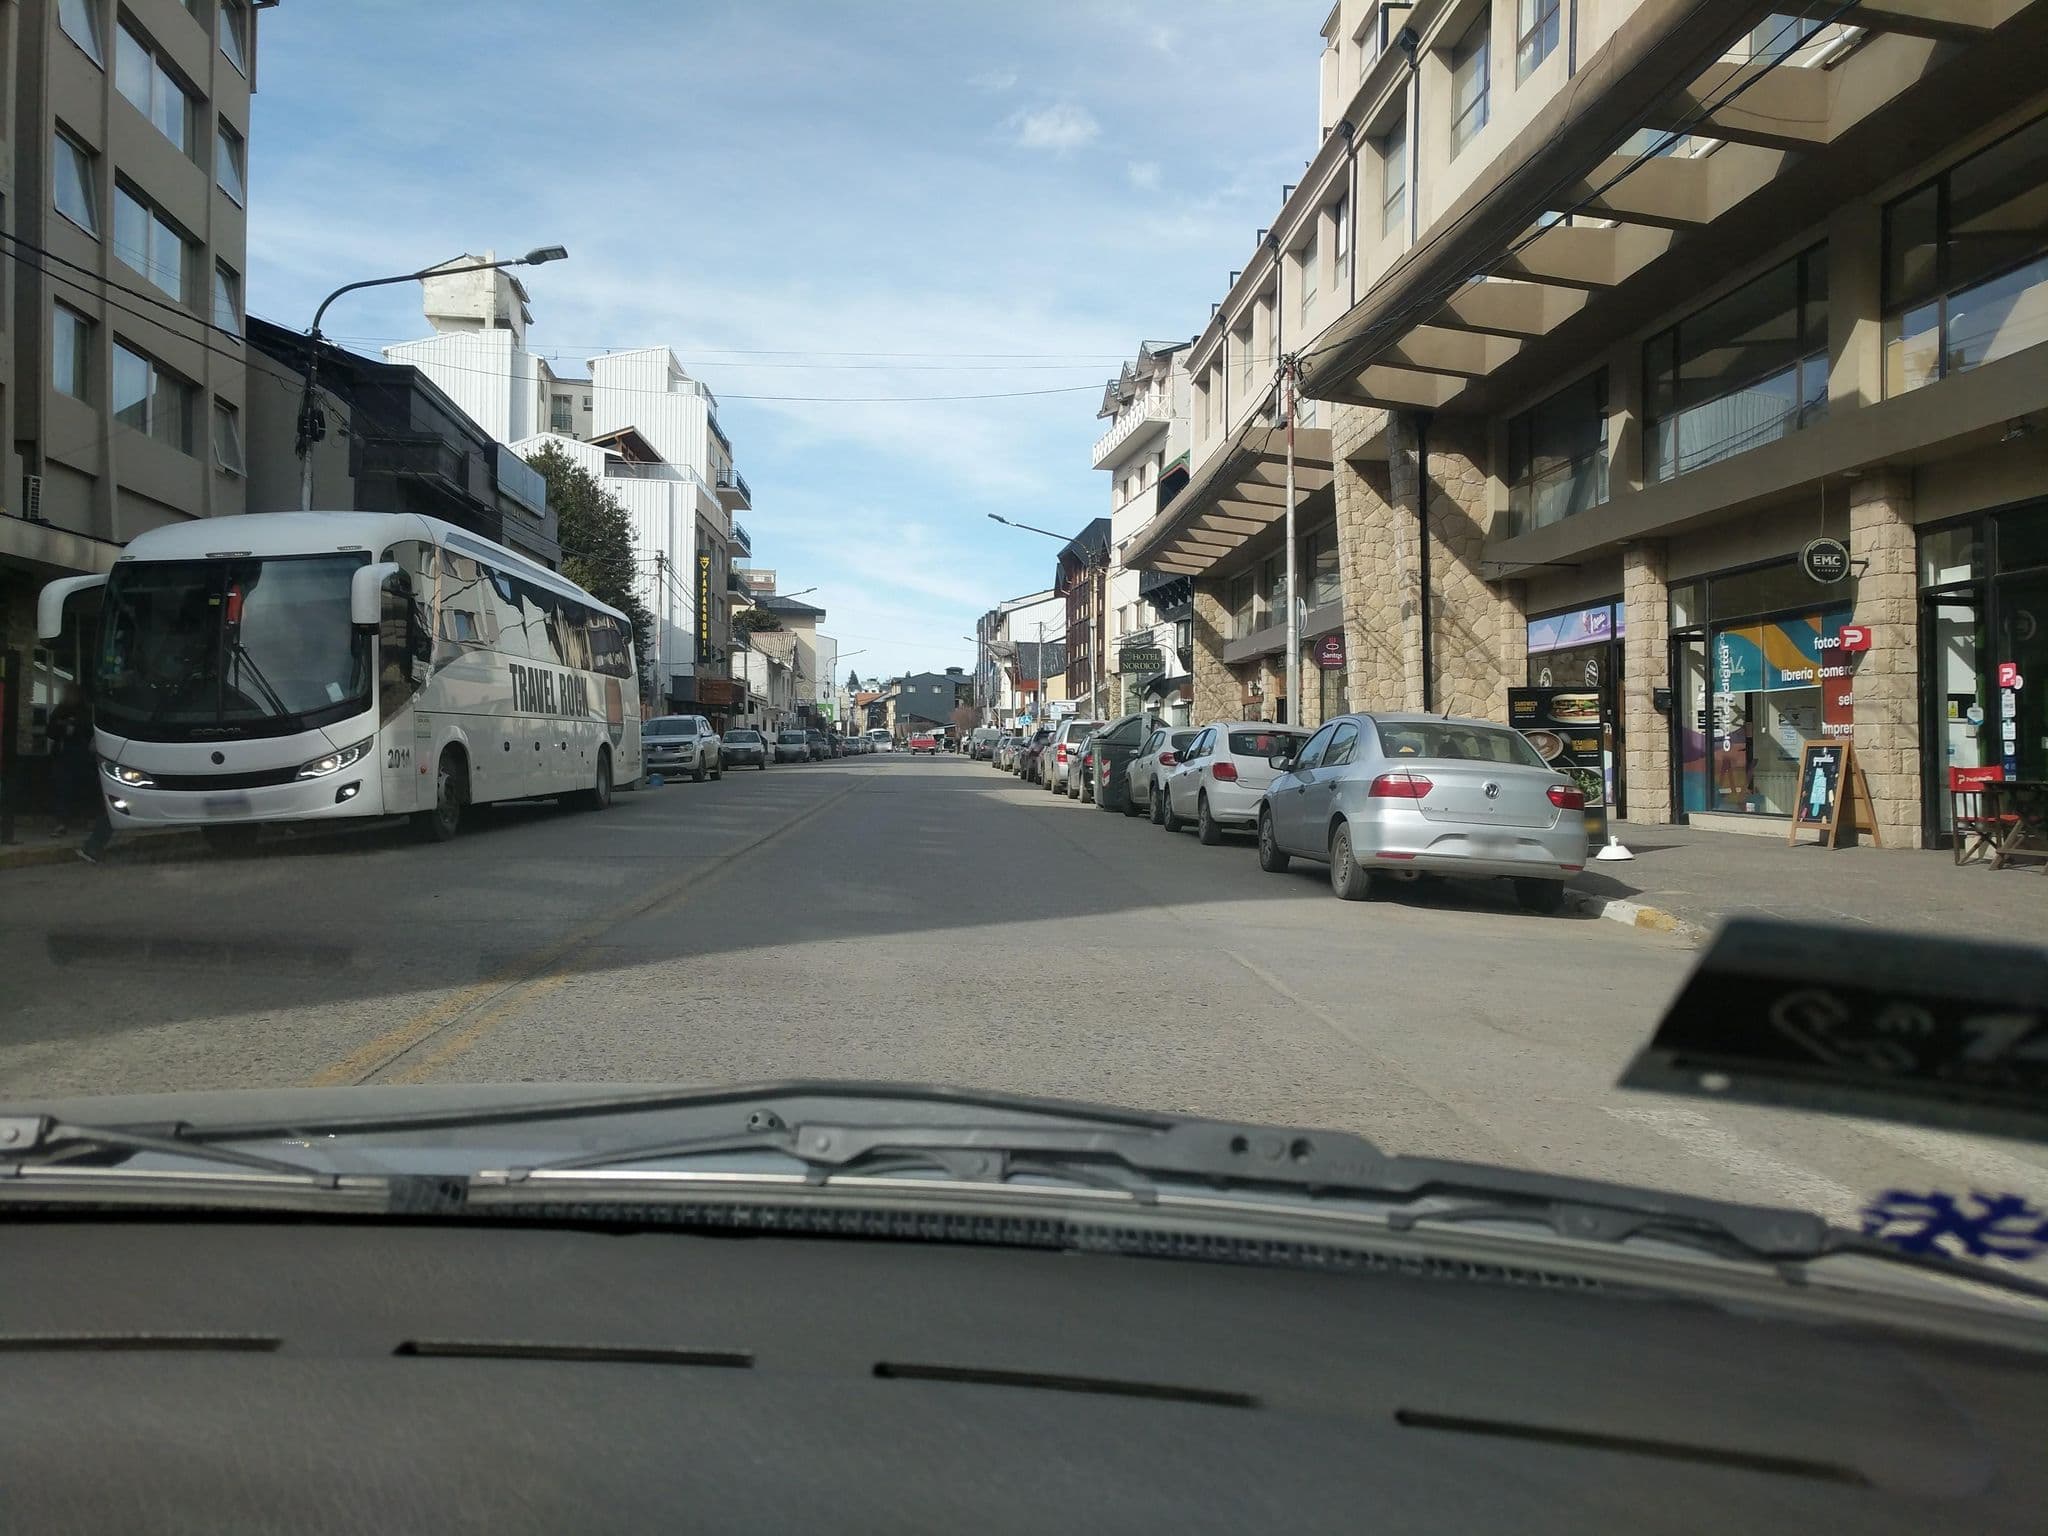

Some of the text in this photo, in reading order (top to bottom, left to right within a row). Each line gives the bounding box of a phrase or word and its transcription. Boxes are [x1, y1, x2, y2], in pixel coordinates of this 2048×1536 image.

[1813, 554, 1841, 566] EMC
[1132, 653, 1159, 661] HOTEL
[509, 663, 589, 717] TRAVEL ROCK
